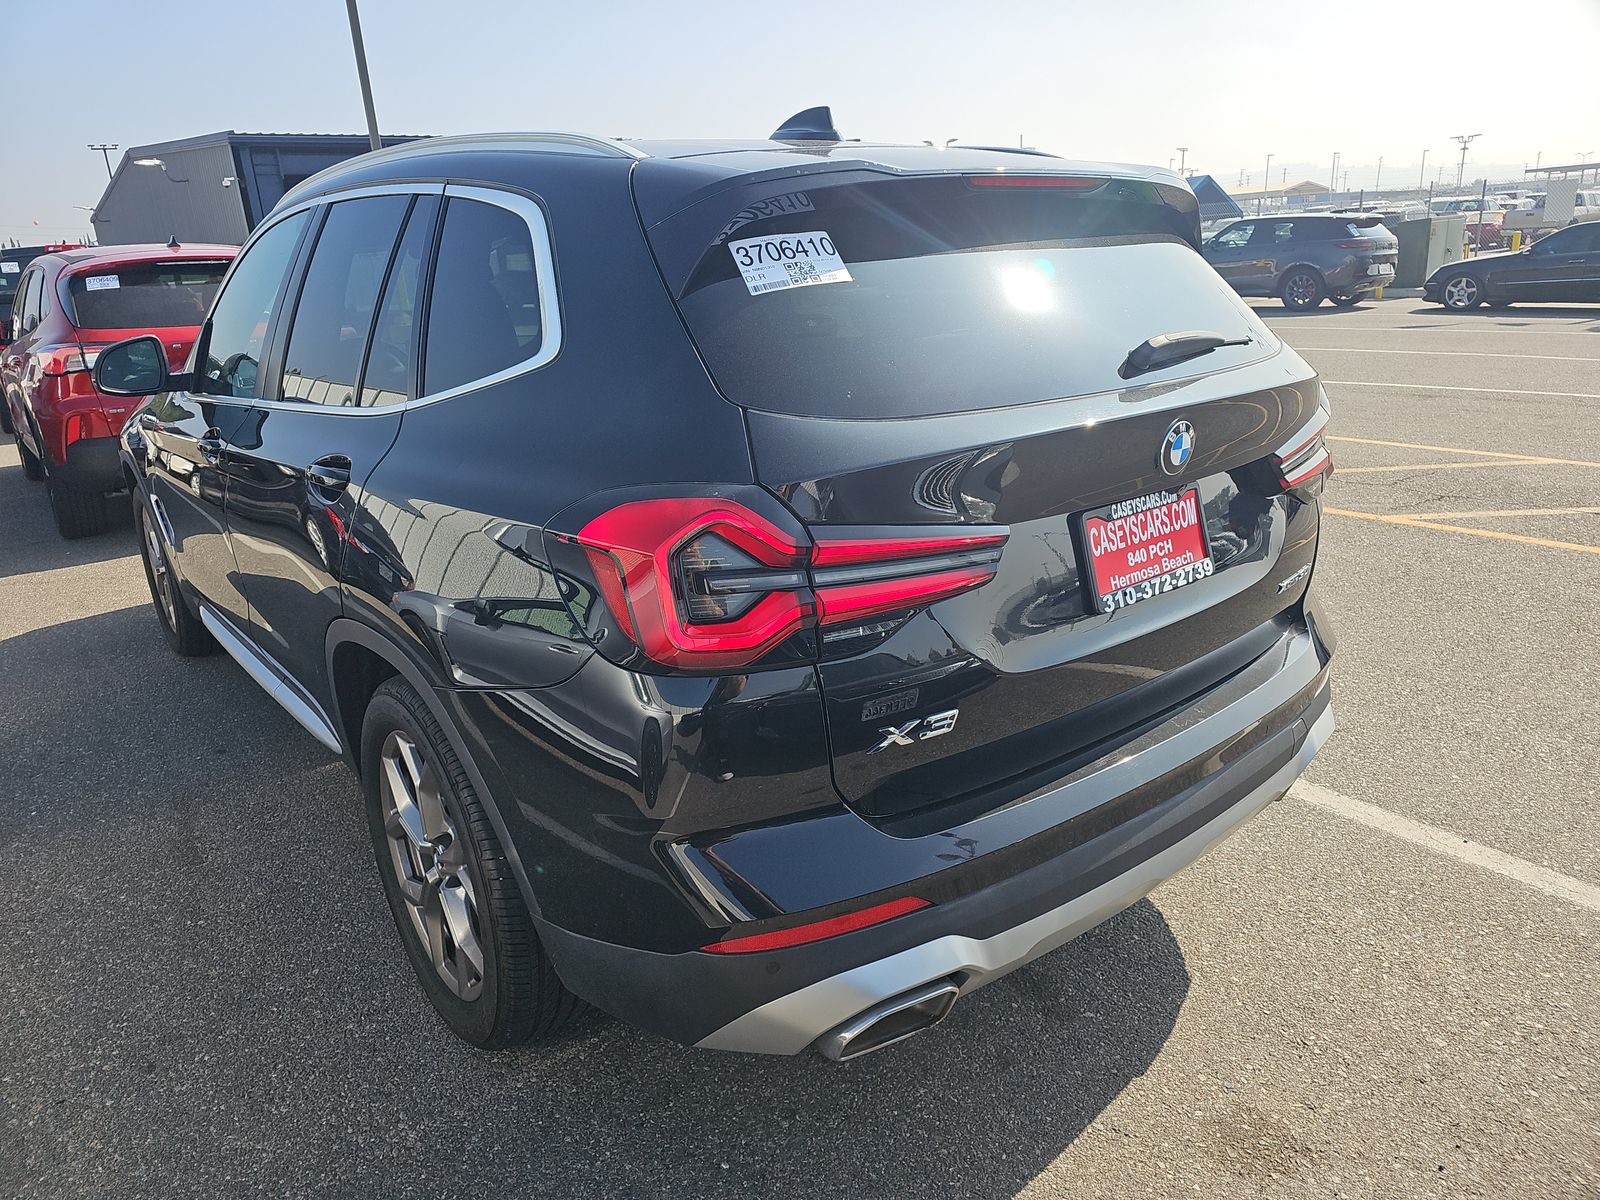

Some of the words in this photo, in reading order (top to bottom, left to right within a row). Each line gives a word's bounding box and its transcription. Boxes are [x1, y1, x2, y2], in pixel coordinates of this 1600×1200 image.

[736, 236, 836, 267] 3706410
[745, 273, 767, 283] DLR
[1090, 497, 1198, 557] CASEYSCARS.COM
[1110, 563, 1160, 590] Hermosa
[1162, 550, 1194, 574] Beach
[1127, 548, 1147, 567] 840
[1149, 539, 1173, 559] PCH
[1102, 559, 1214, 613] 310-372-2739
[865, 709, 960, 755] X3
